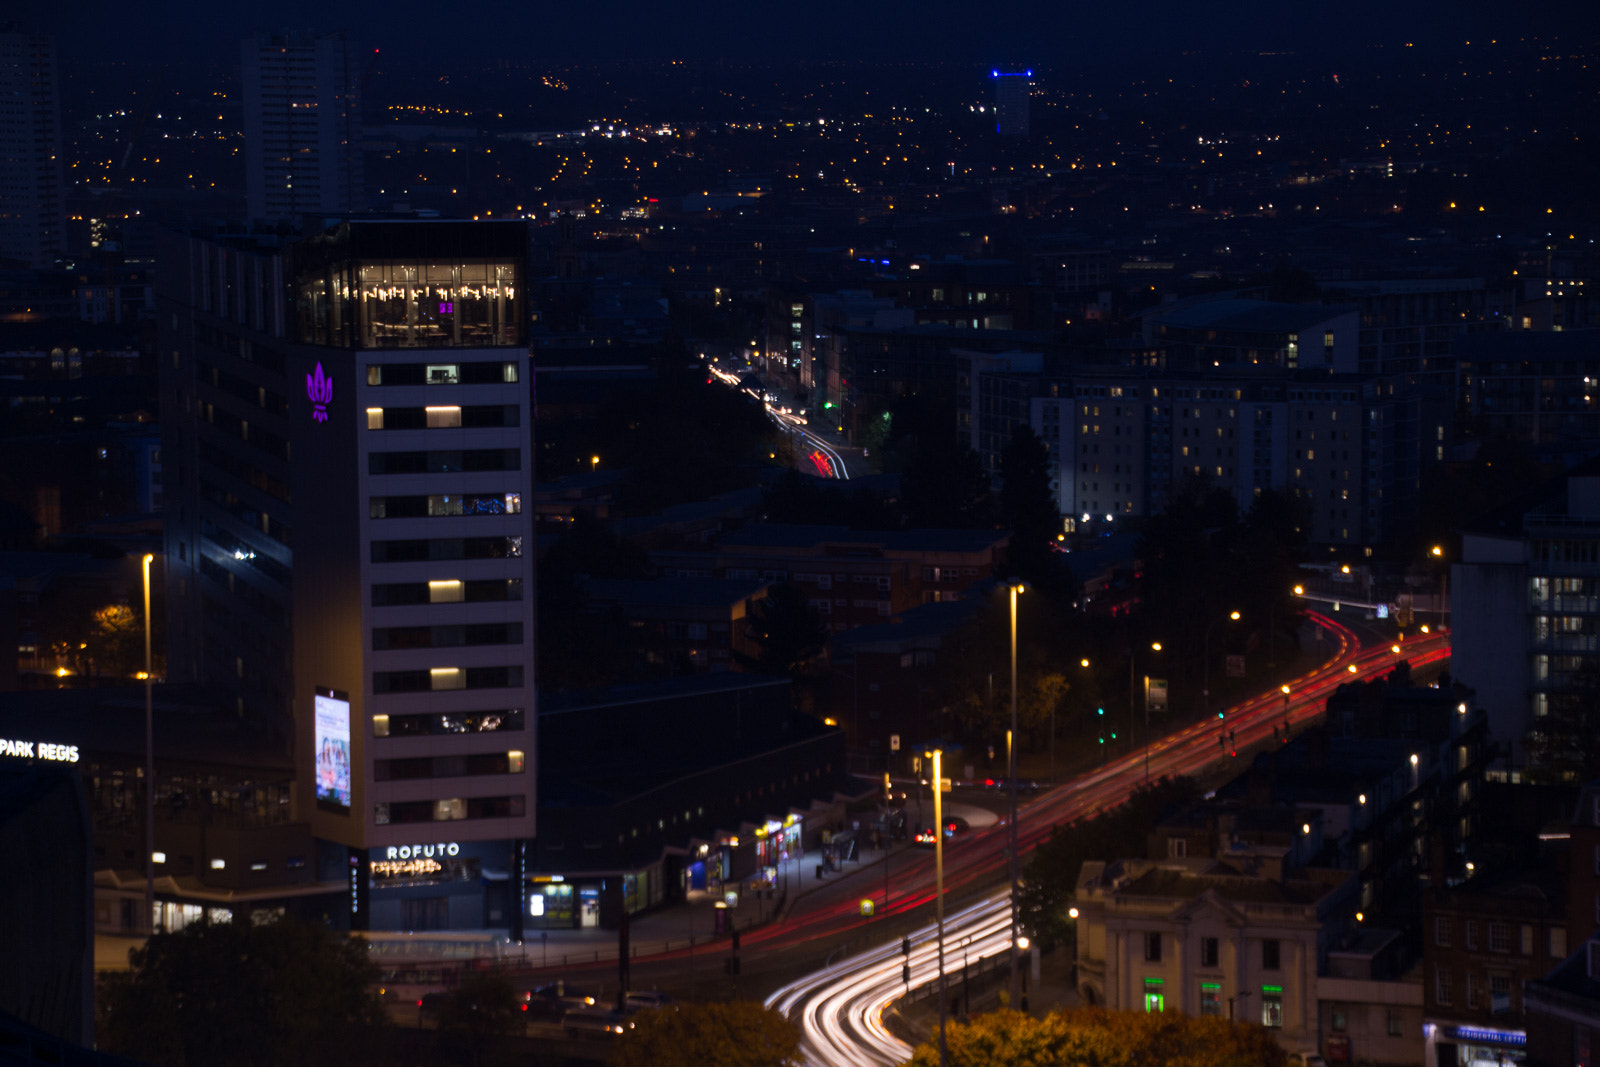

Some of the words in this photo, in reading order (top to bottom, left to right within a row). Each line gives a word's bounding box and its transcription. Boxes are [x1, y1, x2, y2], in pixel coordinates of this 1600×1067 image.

[0, 739, 34, 757] PARK
[38, 743, 79, 762] REGIS
[387, 842, 460, 859] ROFUTO
